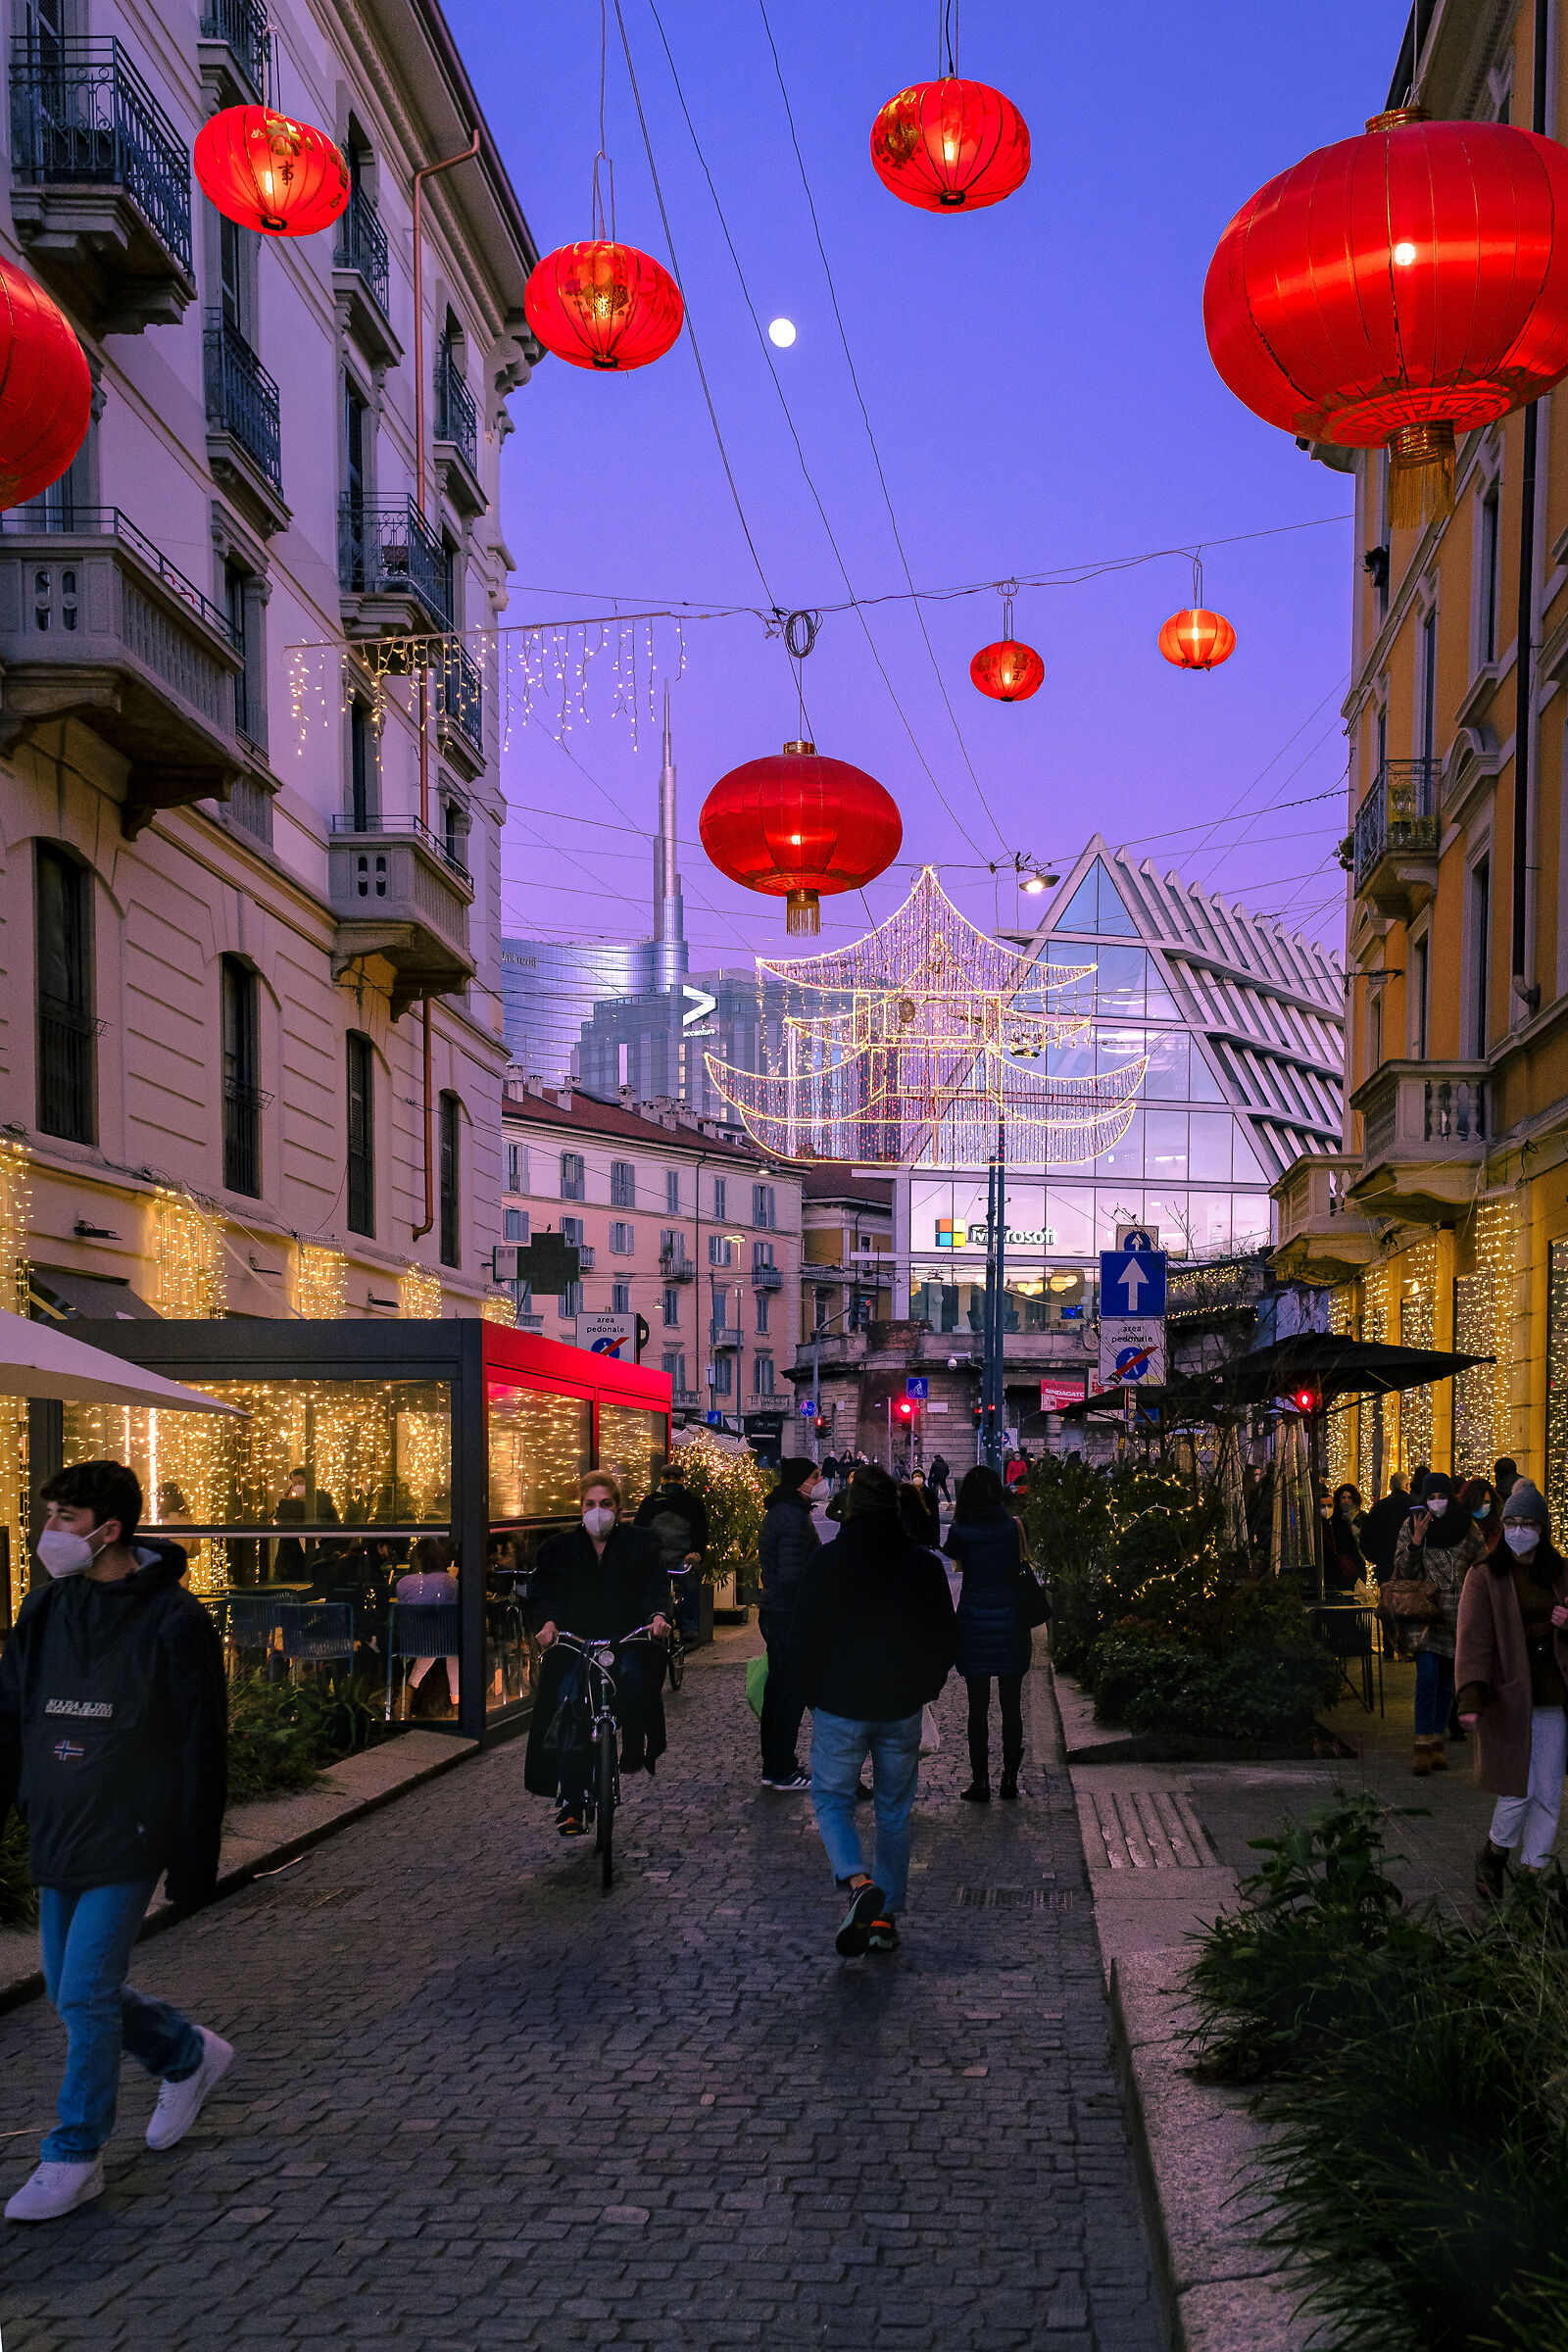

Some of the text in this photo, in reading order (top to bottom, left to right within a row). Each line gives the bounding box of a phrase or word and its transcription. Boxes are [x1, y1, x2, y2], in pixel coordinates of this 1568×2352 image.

[682, 1028, 716, 1038] accenture
[971, 1226, 1058, 1245] Mrosoft
[586, 1325, 625, 1334] pedonale
[1111, 1335, 1153, 1344] pedonale
